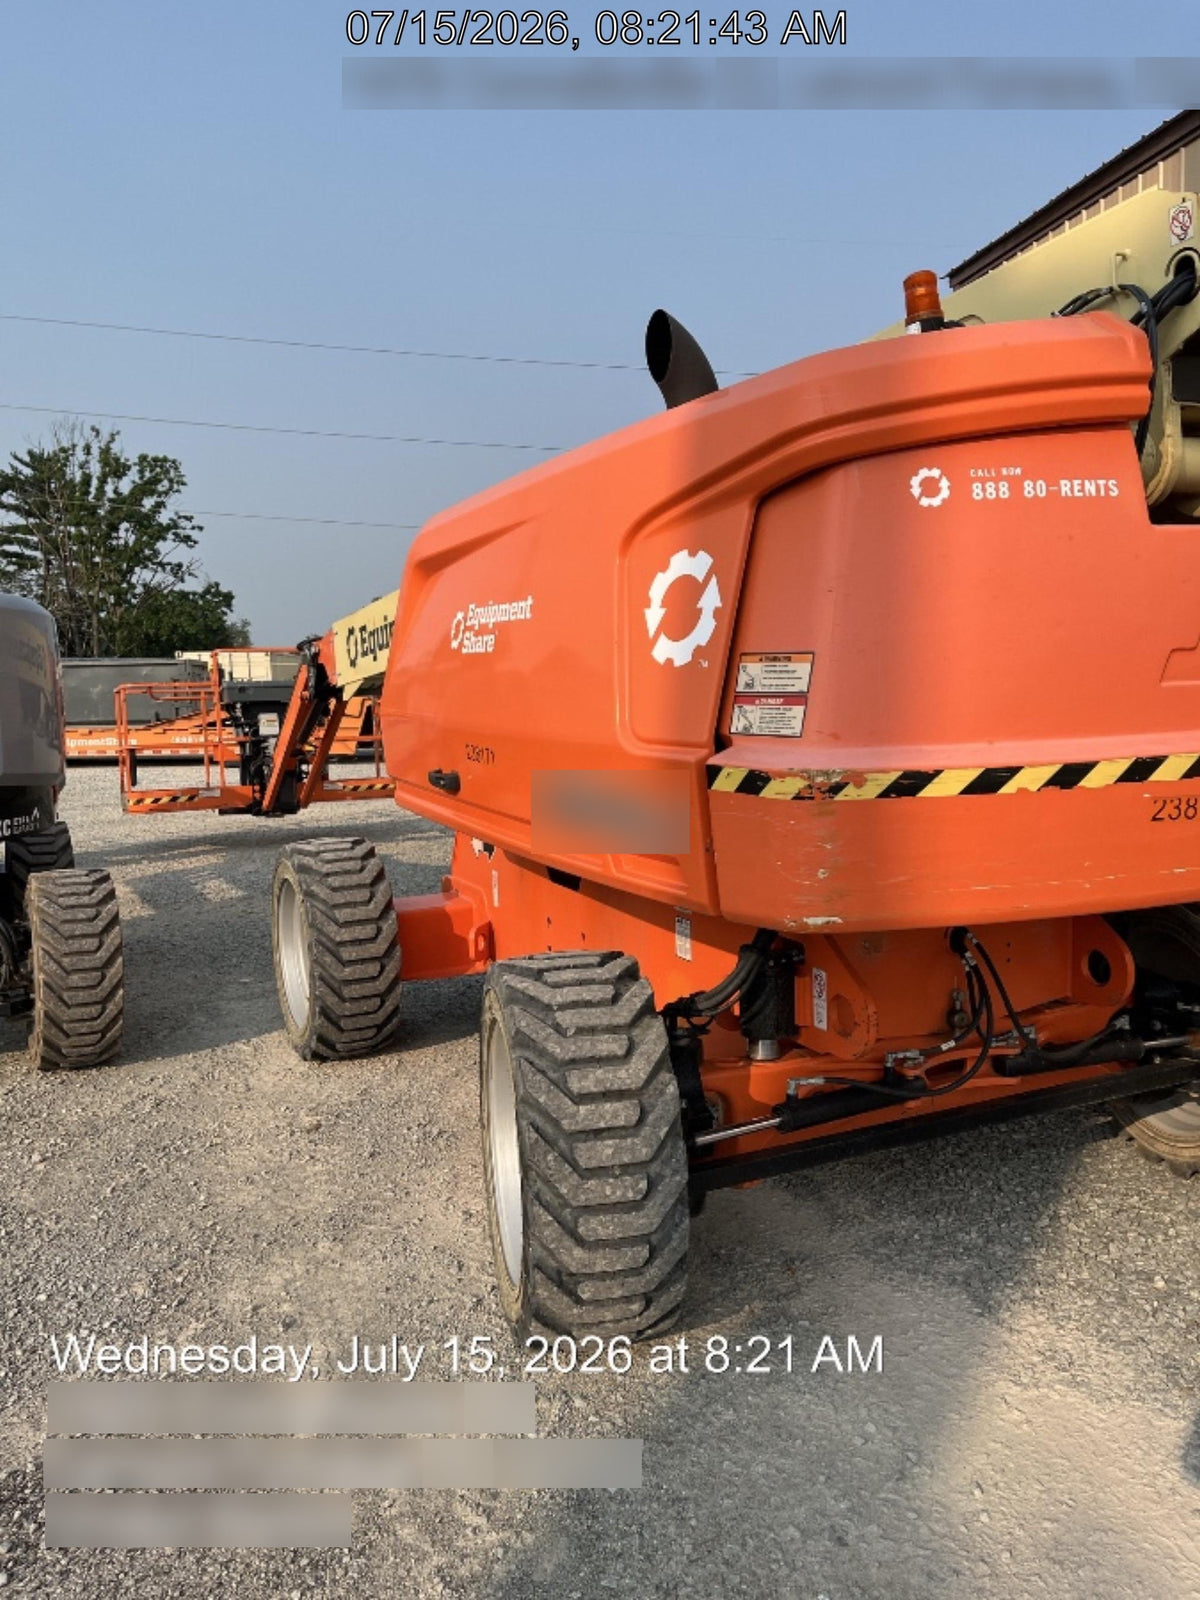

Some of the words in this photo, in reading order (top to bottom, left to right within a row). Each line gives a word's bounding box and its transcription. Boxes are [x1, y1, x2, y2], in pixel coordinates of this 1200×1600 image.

[972, 481, 1010, 500] 888
[1023, 479, 1120, 498] 80-RENTS
[466, 595, 534, 630] Equipment
[462, 630, 496, 654] Share
[1150, 797, 1198, 822] 238
